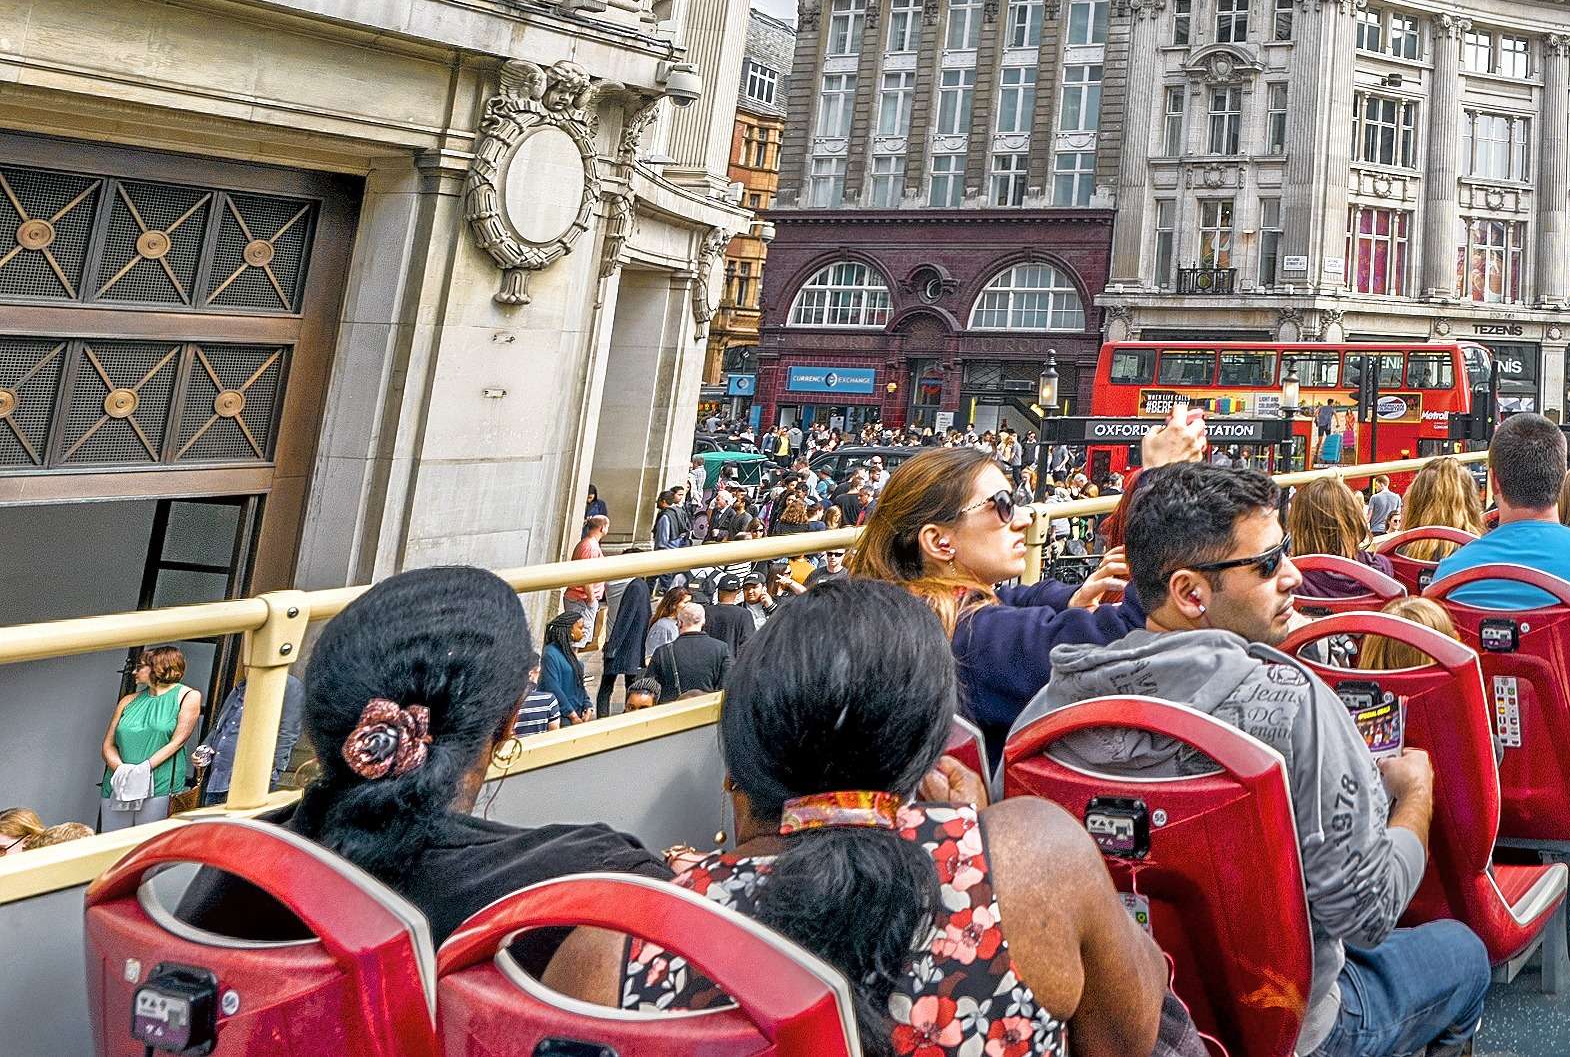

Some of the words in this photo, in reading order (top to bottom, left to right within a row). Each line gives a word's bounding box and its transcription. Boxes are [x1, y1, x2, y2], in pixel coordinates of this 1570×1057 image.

[792, 375, 825, 383] CURRENCY
[838, 376, 871, 384] EXCHANGE
[1095, 424, 1147, 436] OXFORD
[1203, 425, 1254, 436] STATION
